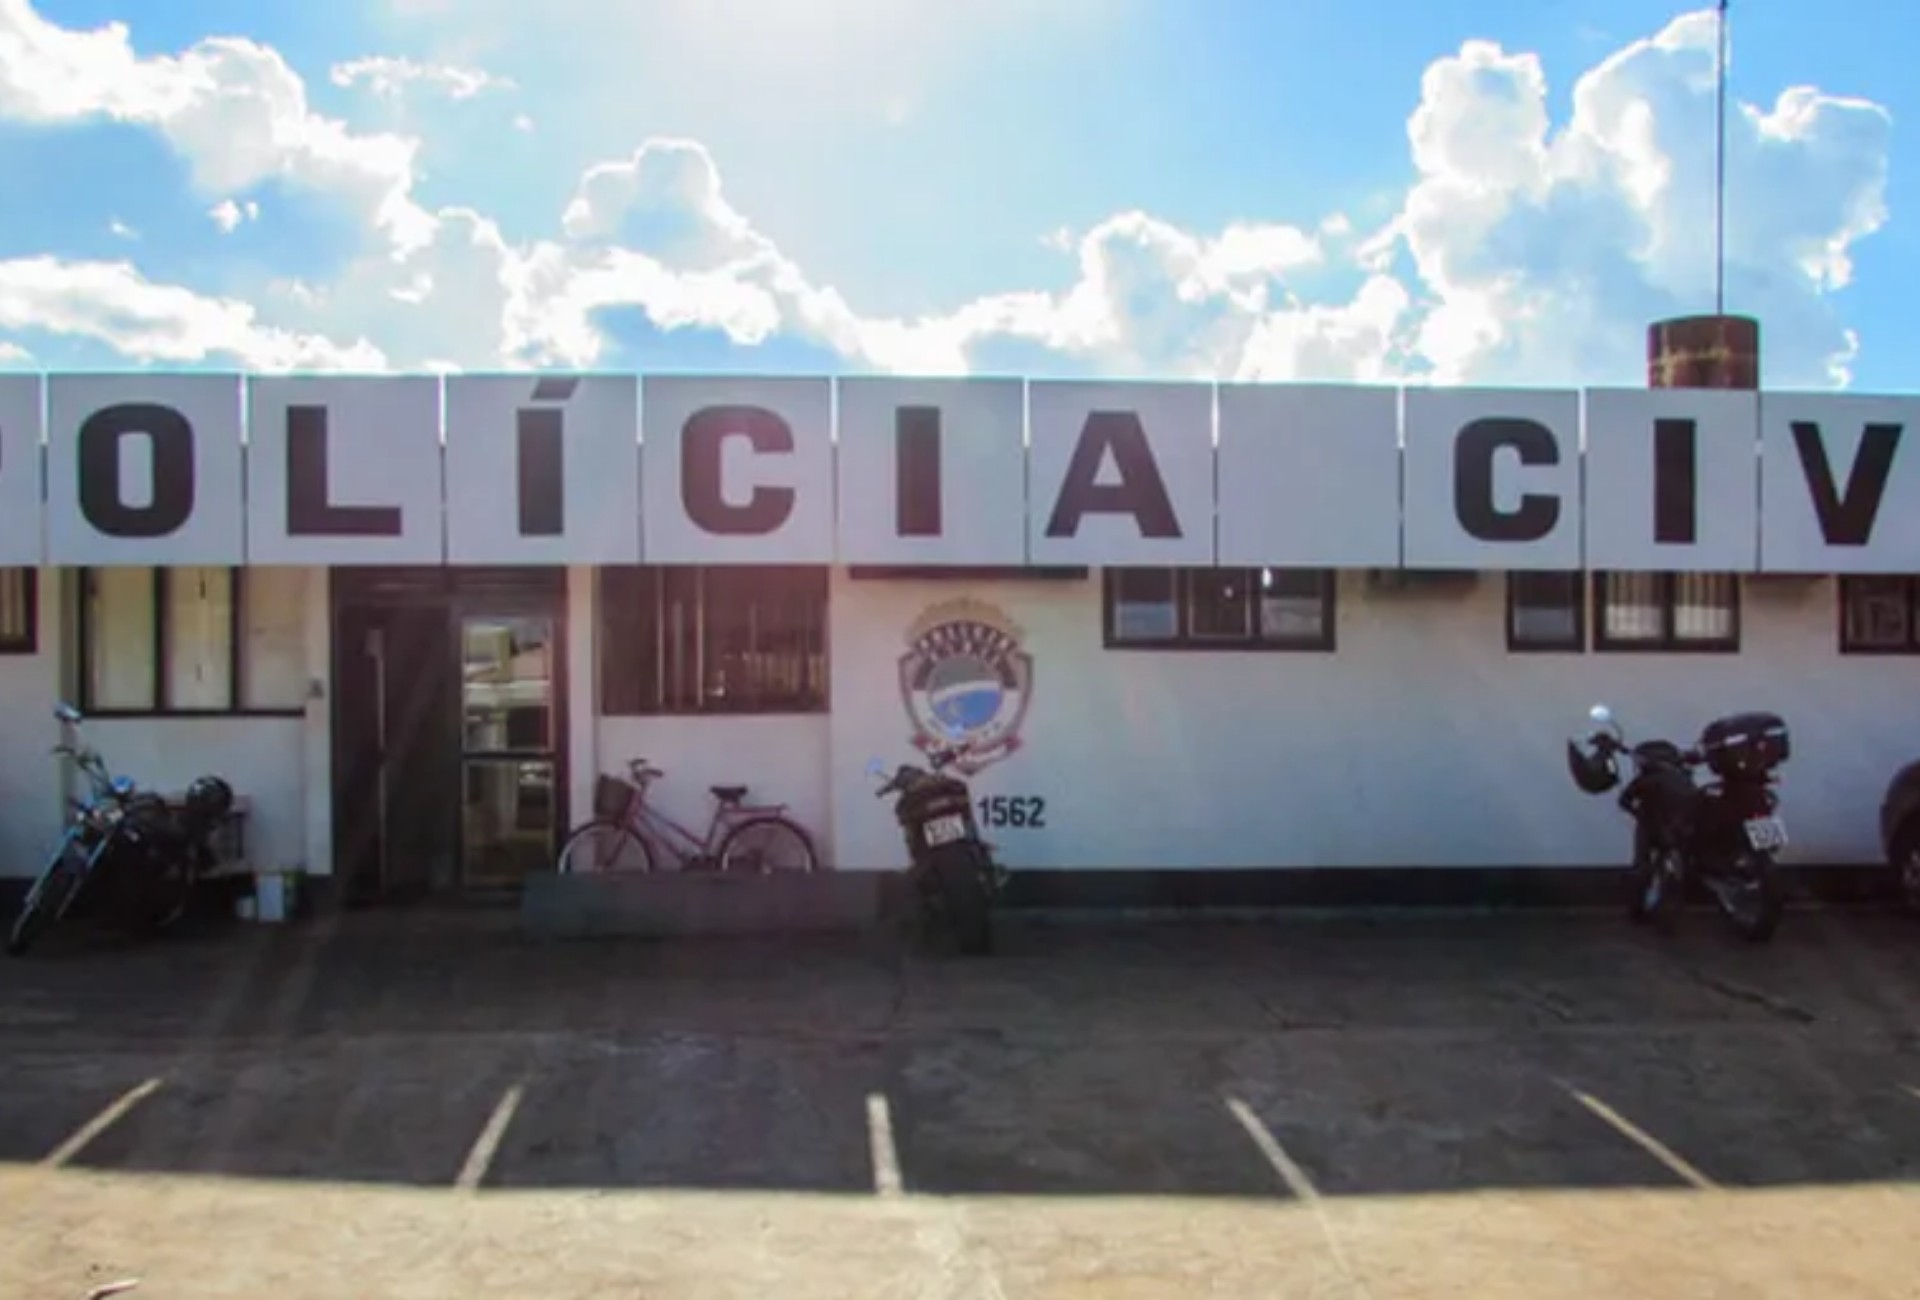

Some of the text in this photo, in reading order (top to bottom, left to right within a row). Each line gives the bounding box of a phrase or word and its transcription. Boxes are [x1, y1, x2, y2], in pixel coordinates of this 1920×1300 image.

[0, 378, 1903, 545] OLÍCIA CIV
[977, 797, 1046, 828] 1562
